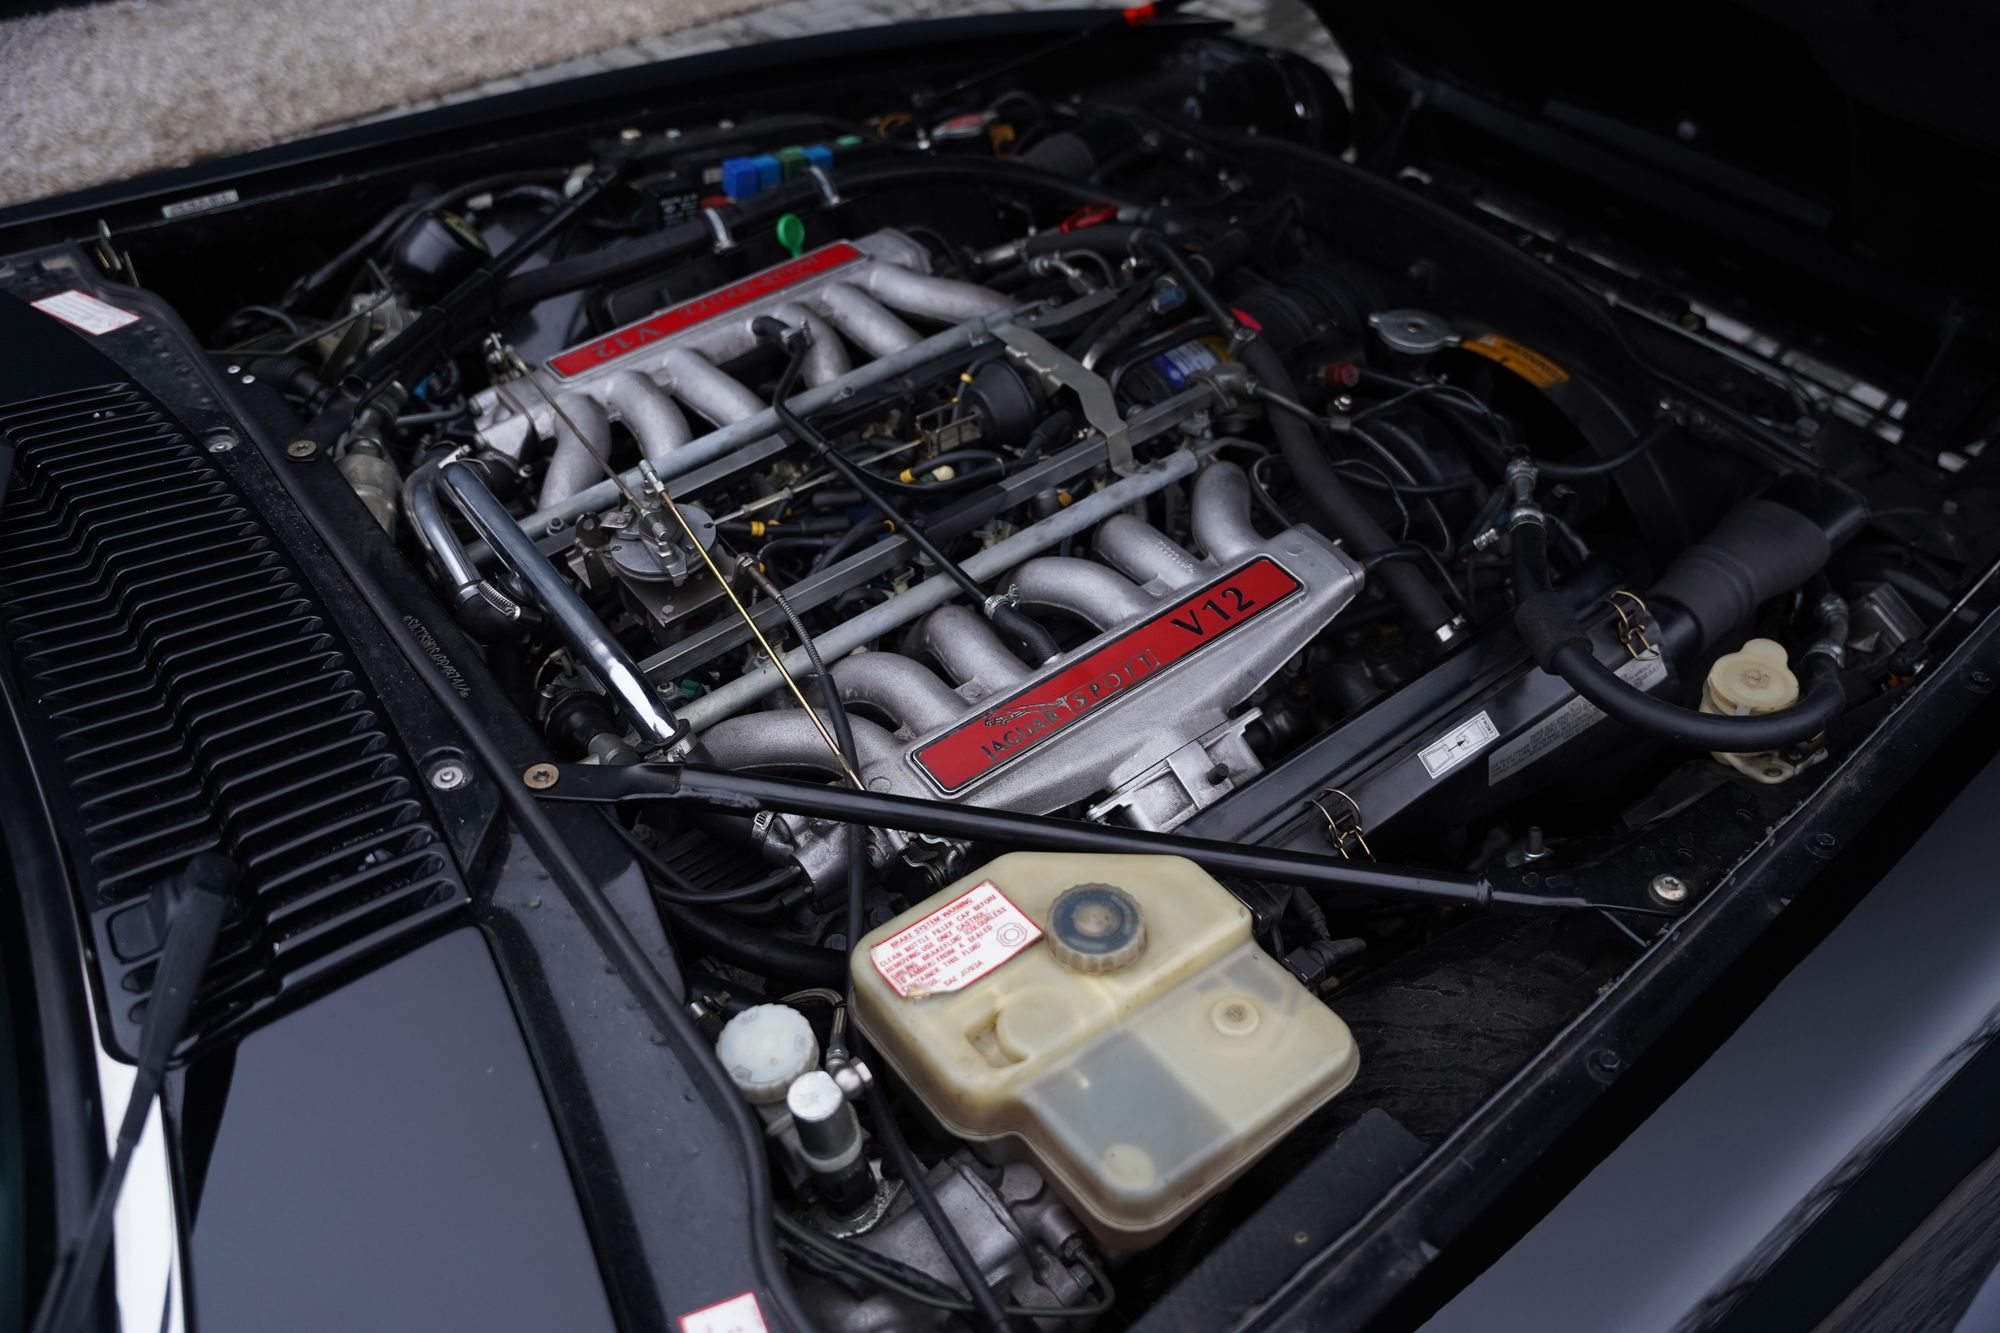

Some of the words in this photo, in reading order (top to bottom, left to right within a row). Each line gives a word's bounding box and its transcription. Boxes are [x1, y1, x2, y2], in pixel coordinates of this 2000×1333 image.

[980, 708, 1062, 761] JAGUAR
[1074, 655, 1153, 707] SPORT
[1171, 585, 1255, 637] V12
[880, 952, 902, 967] CLEAN
[905, 936, 929, 952] BOTTLE
[933, 921, 954, 936] FILLER
[956, 911, 970, 922] CAP
[974, 894, 997, 910] BEFORE
[890, 934, 912, 948] BRAKE
[914, 916, 940, 934] SYSTEM
[943, 898, 972, 918] WARNING
[922, 943, 935, 952] USE
[936, 948, 955, 962] FROM
